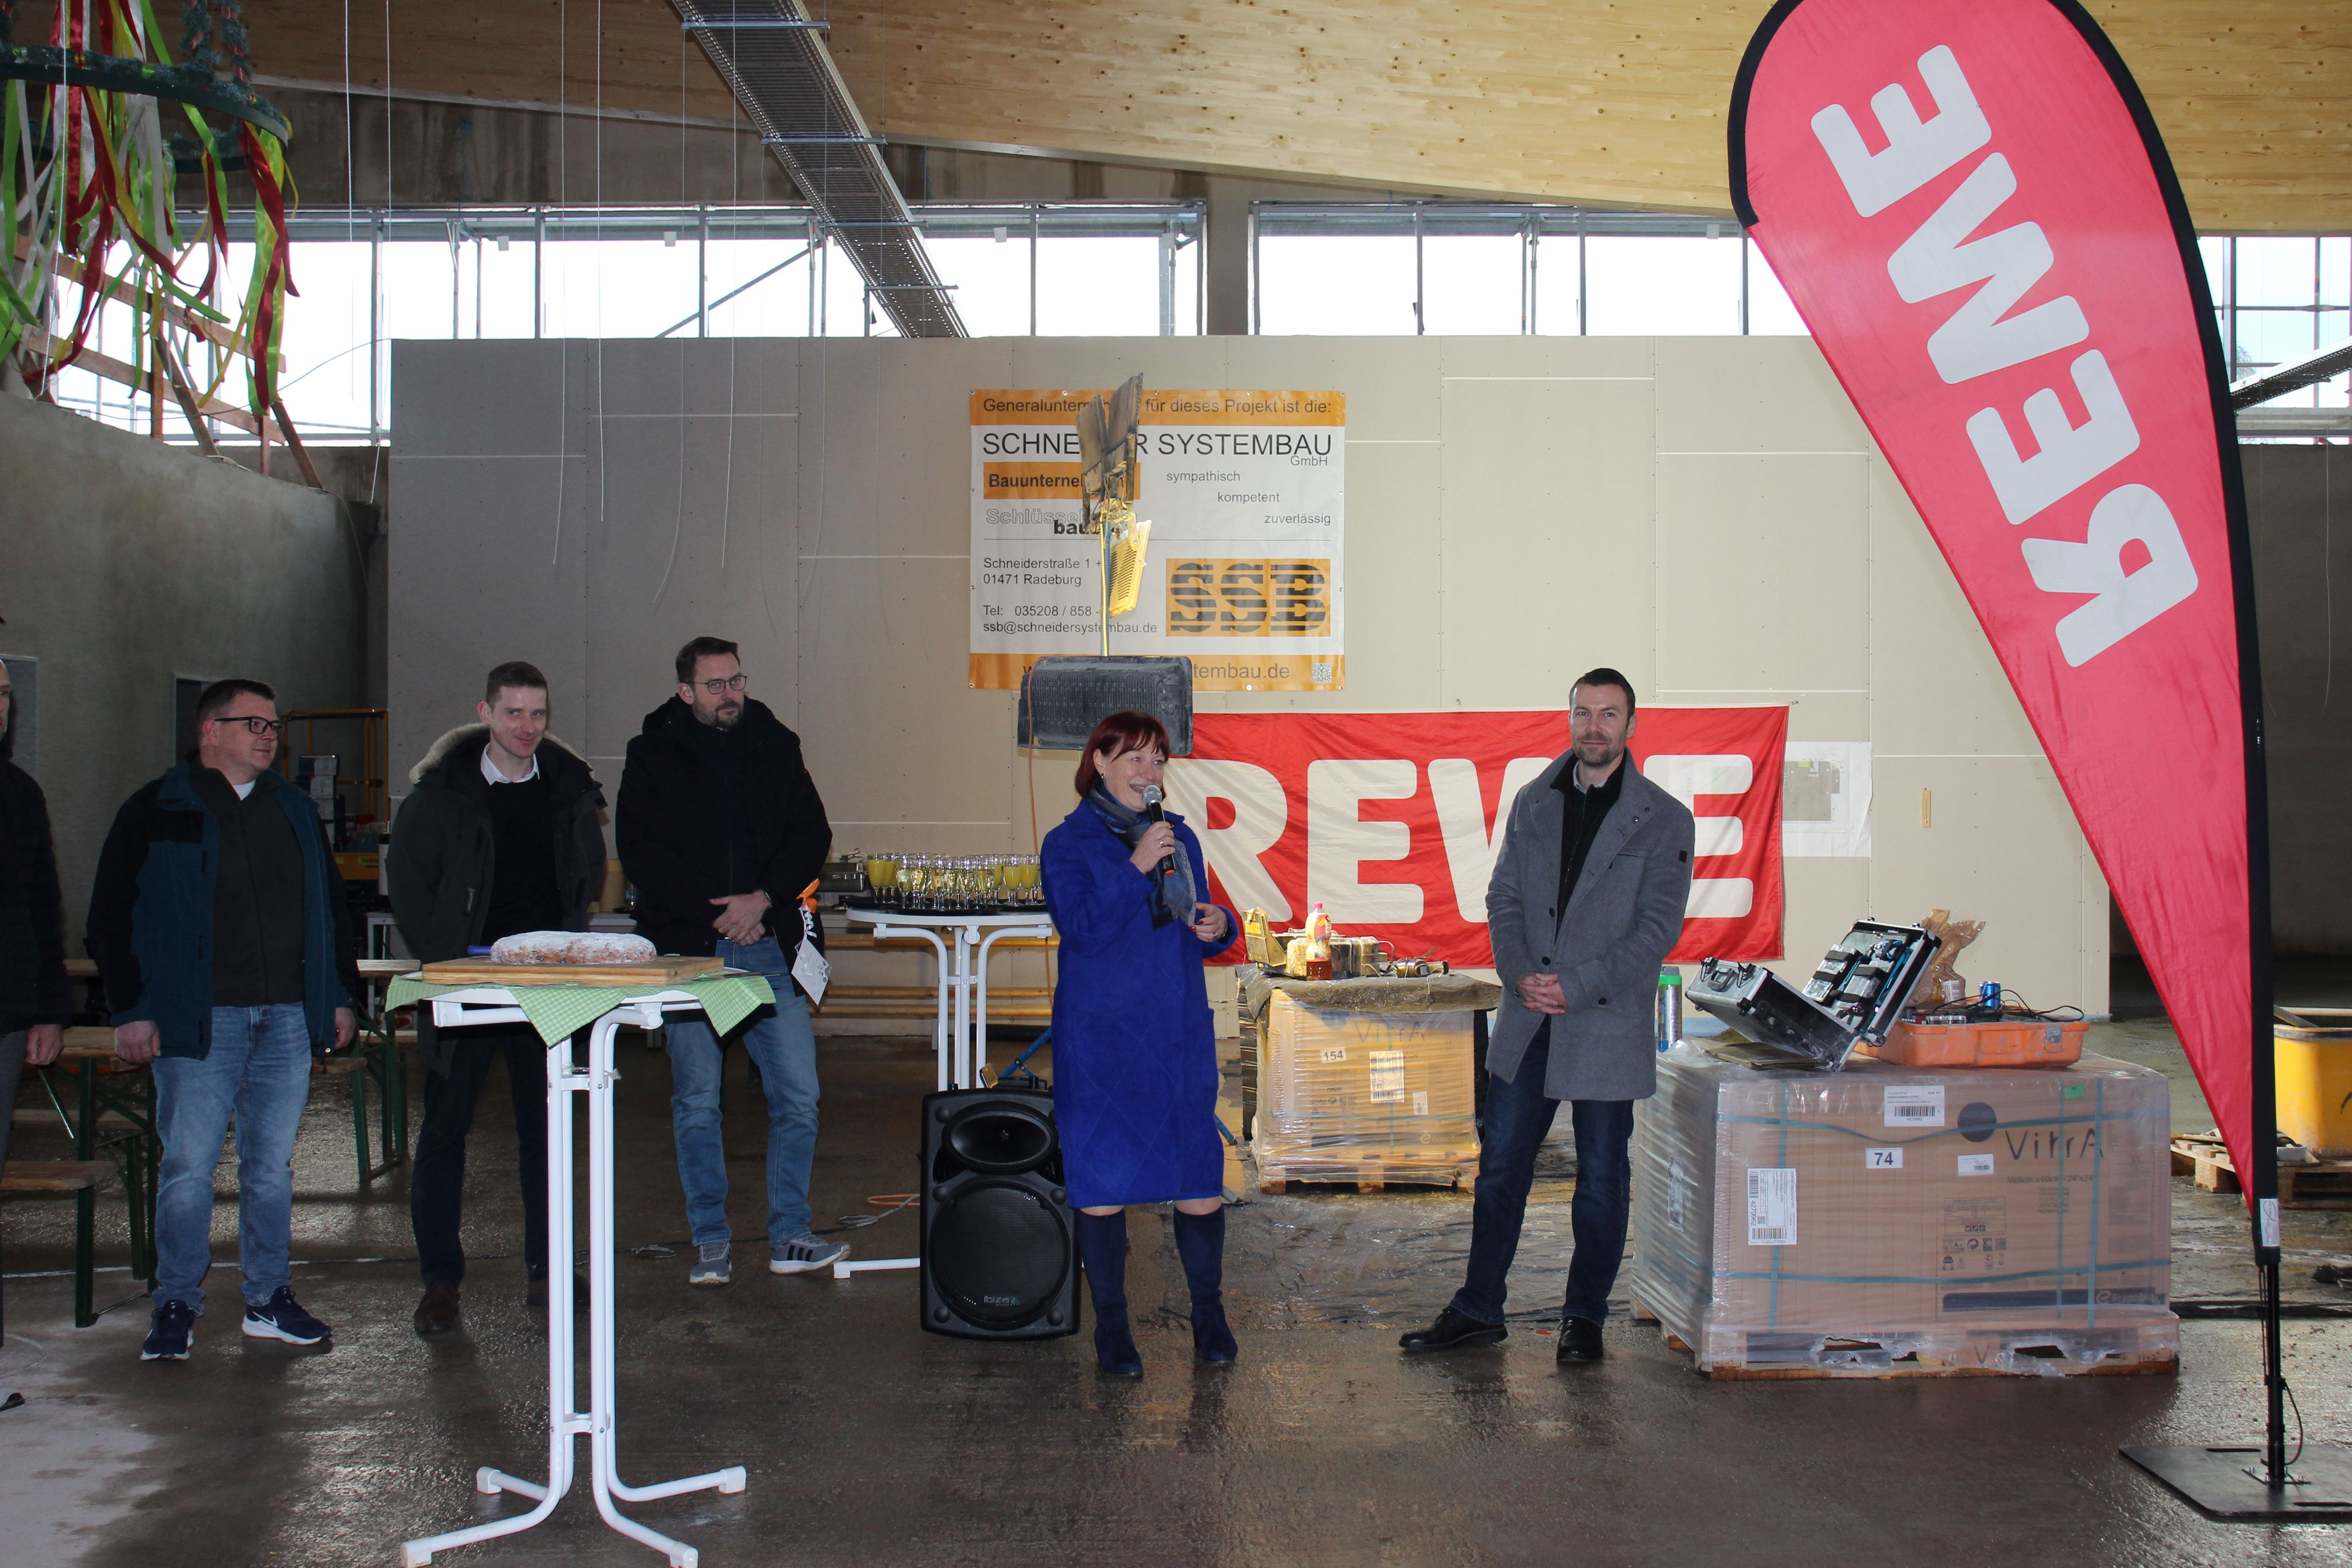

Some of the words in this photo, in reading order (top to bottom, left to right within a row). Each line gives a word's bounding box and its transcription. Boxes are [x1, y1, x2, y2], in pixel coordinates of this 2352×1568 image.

[984, 398, 1110, 412] Generalunter
[1146, 398, 1166, 412] für
[1171, 399, 1219, 412] dieses
[1225, 399, 1278, 416] Projekt
[1283, 400, 1299, 413] ist
[1304, 400, 1331, 413] die:
[983, 432, 1149, 455] SCHNER
[1158, 433, 1331, 456] SYSTEMBAU
[1290, 455, 1328, 466] GmbH
[1166, 471, 1240, 484] sympathisch
[1218, 492, 1280, 505] kompetent
[1264, 513, 1331, 526] zuverlässig
[984, 558, 1080, 569] Schneiderstraße
[1085, 559, 1090, 568] 1
[983, 573, 1019, 584] 01471
[1024, 574, 1082, 587] Radeburg
[1171, 563, 1326, 632] SSB
[983, 605, 1003, 616] Tel:
[1014, 606, 1058, 616] 035208
[1070, 606, 1092, 616] 858
[1323, 1050, 1344, 1062] 154
[1874, 1152, 1893, 1166] 74
